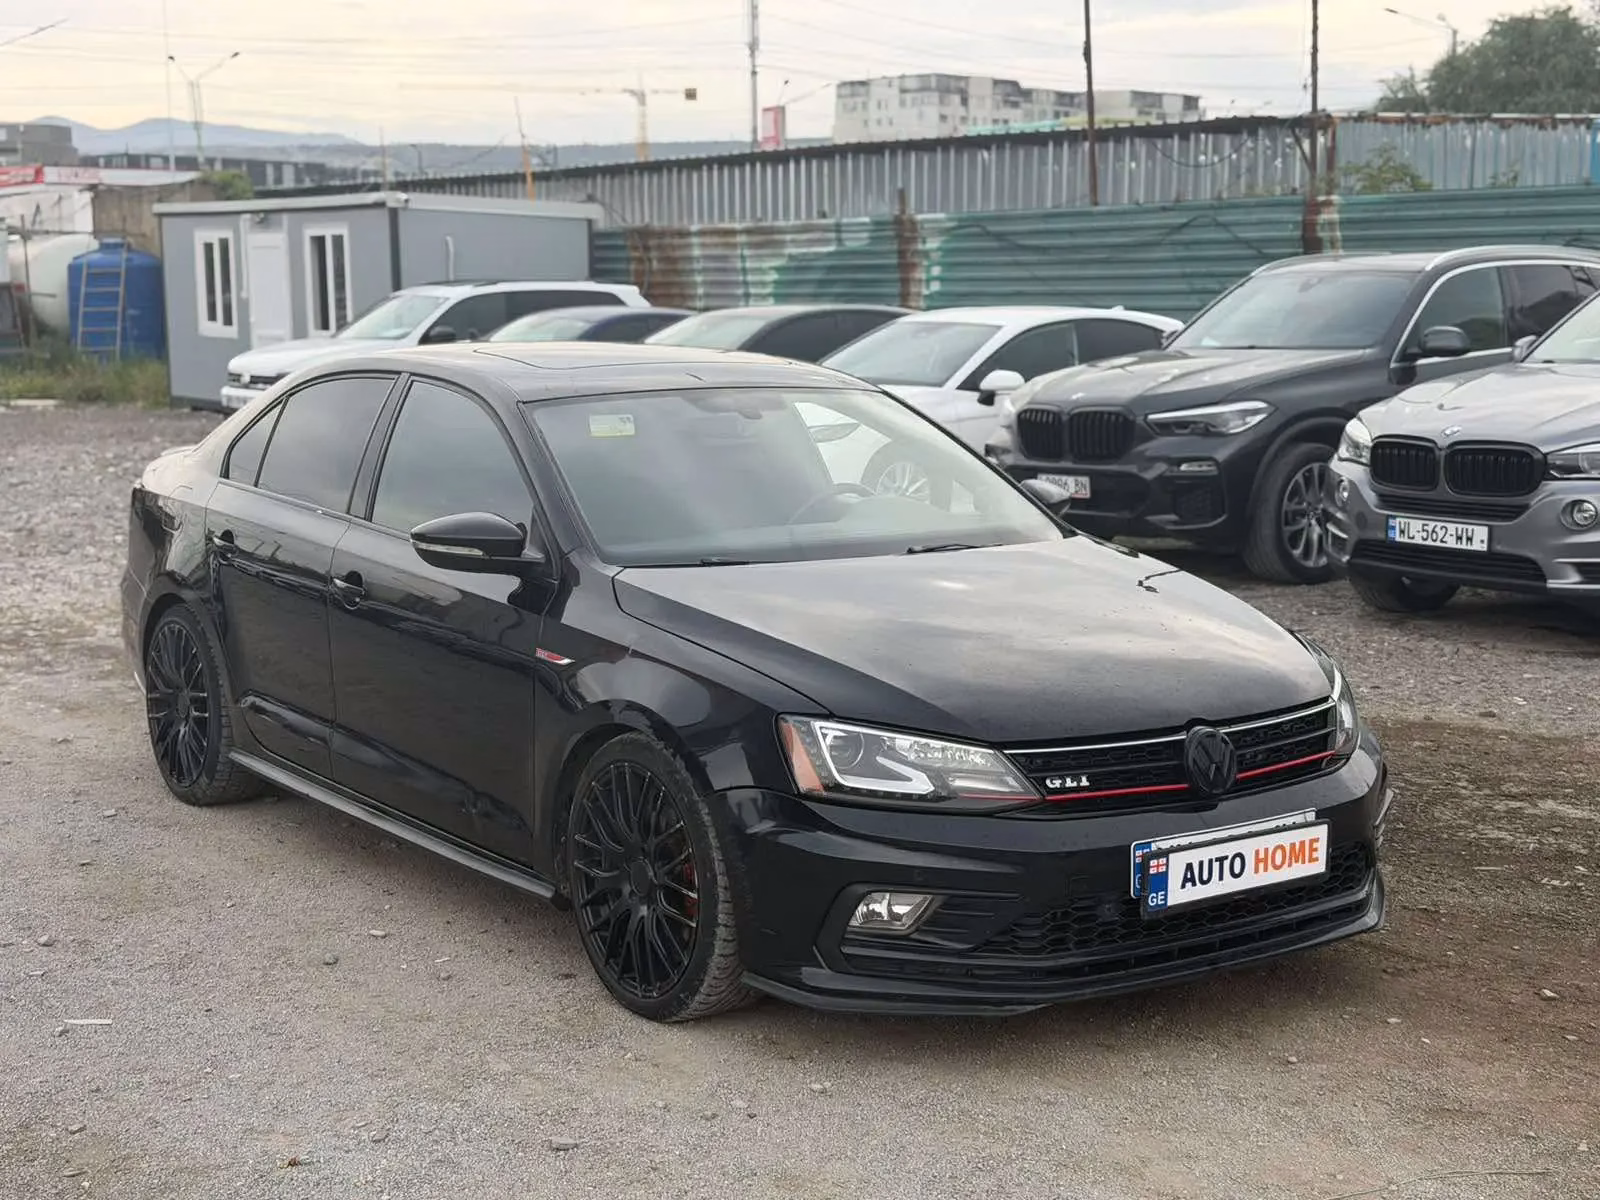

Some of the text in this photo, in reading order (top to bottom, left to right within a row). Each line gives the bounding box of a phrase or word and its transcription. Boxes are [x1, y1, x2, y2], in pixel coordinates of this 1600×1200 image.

[1398, 520, 1475, 547] WL-562-WW
[1045, 775, 1090, 788] GLI
[1180, 852, 1246, 889] AUTO
[1253, 837, 1320, 874] HOME
[1148, 891, 1166, 906] GE
